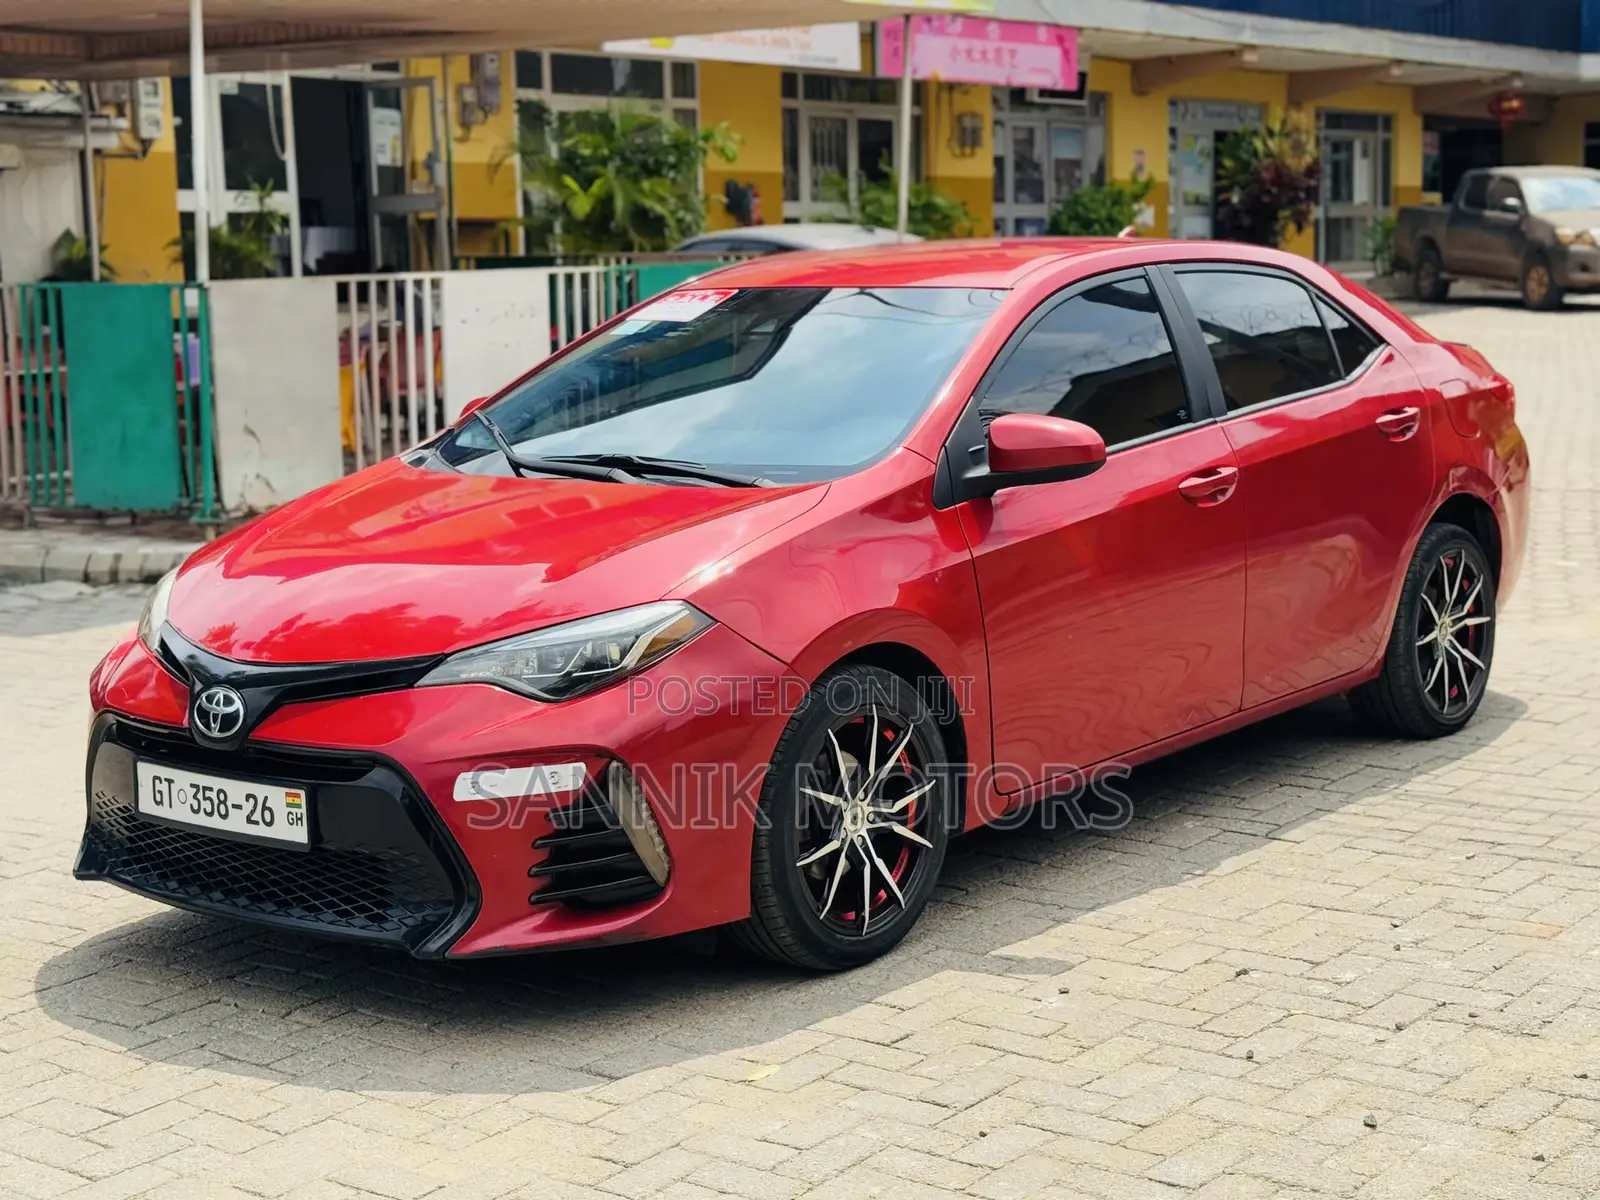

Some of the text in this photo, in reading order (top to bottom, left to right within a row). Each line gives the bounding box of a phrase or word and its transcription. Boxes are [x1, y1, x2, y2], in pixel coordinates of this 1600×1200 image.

[152, 775, 275, 827] GT 358-26
[286, 811, 304, 827] GH
